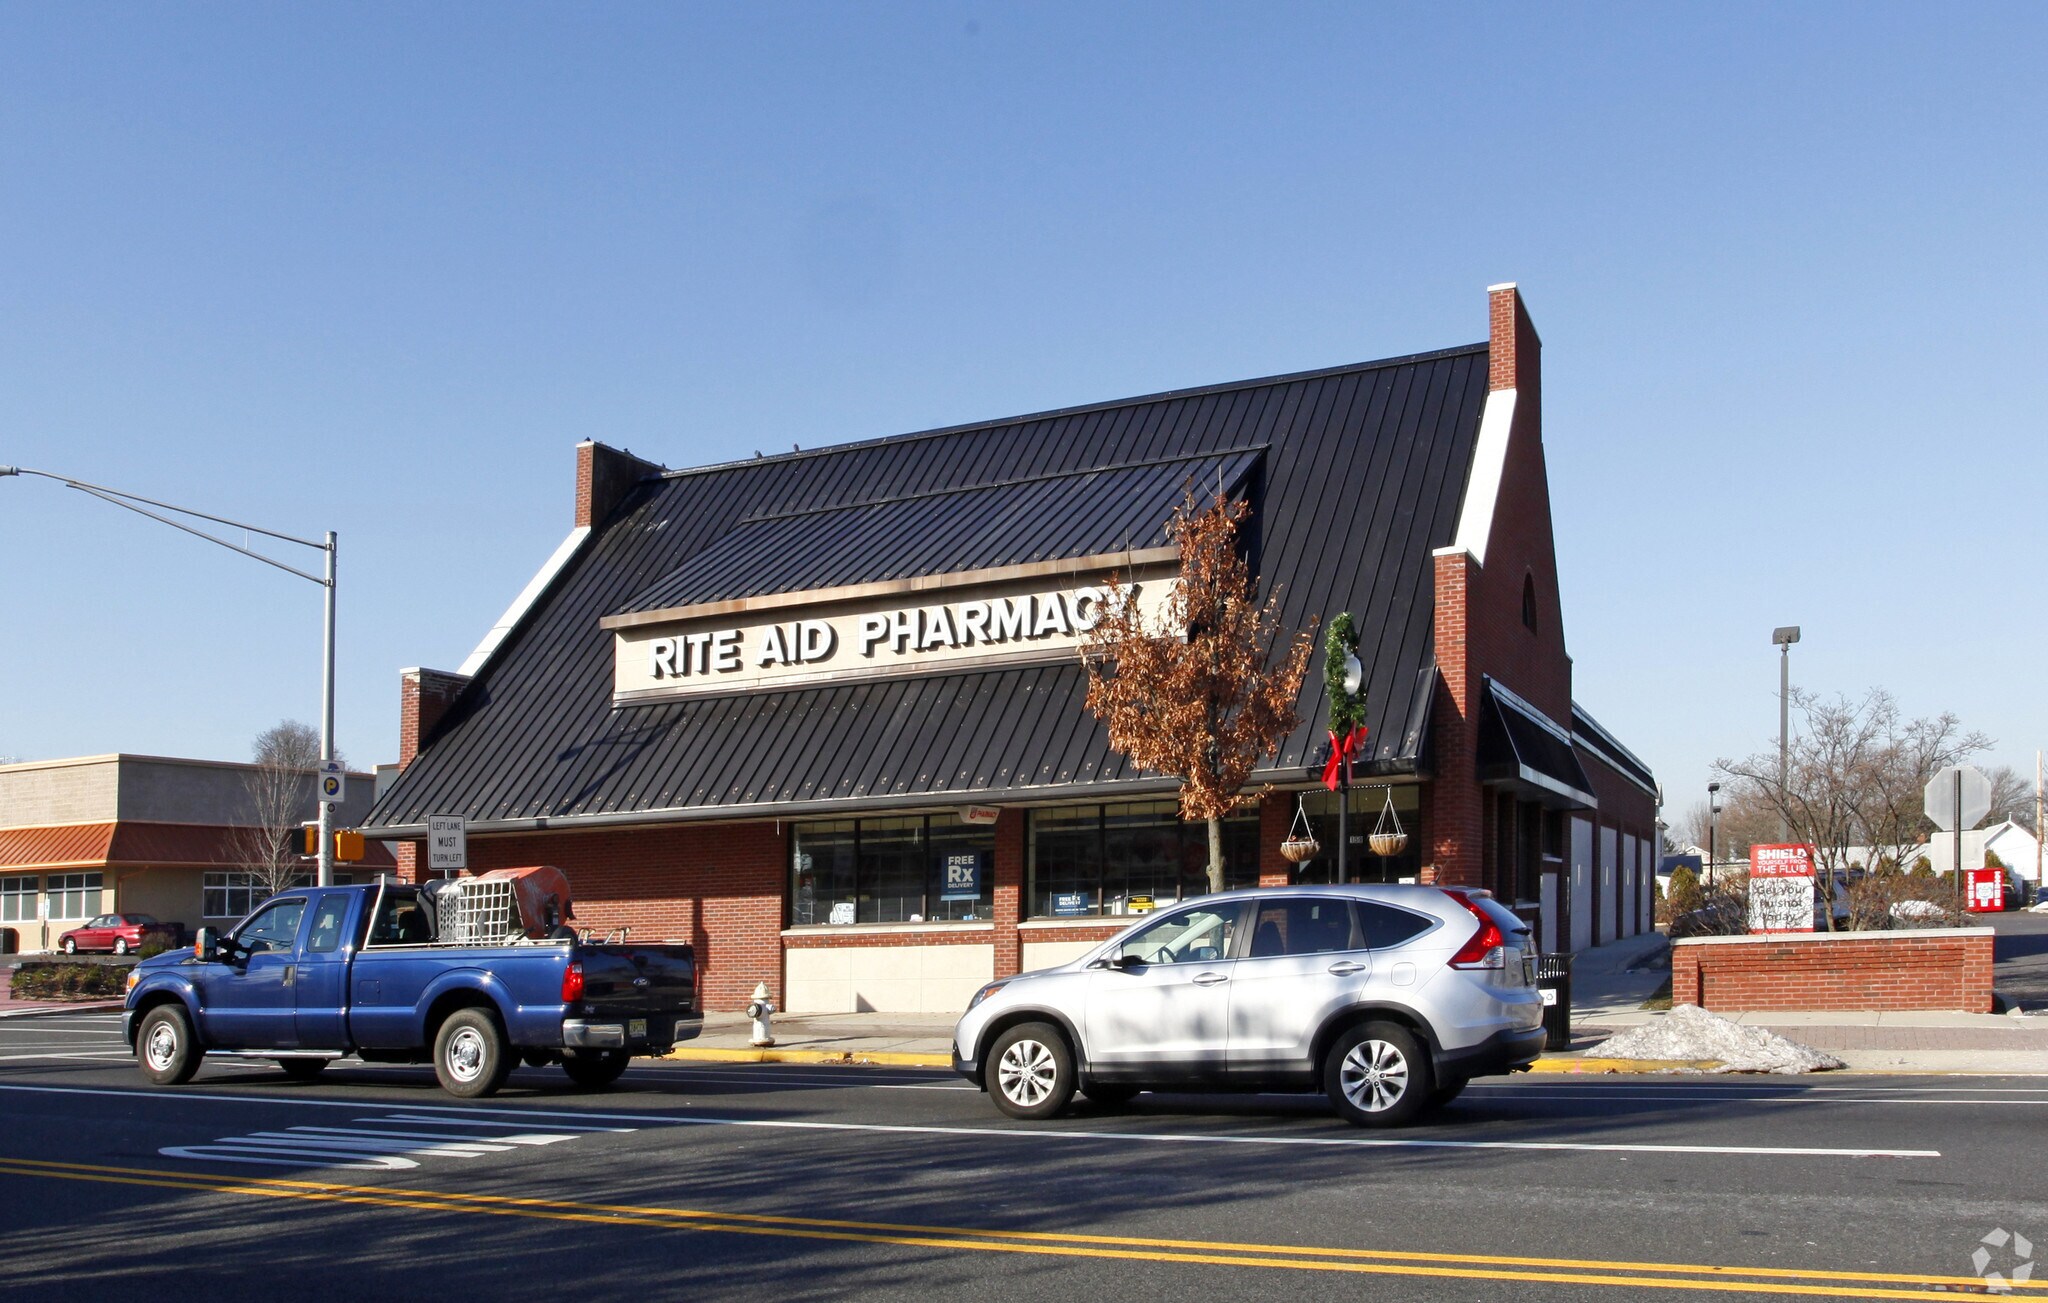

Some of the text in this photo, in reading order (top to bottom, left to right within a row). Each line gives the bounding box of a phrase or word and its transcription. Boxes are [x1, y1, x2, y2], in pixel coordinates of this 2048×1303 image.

[650, 630, 740, 677] RITE
[755, 620, 833, 666] AID
[326, 779, 337, 792] P
[432, 821, 461, 831] LEFT LANE
[438, 836, 457, 847] MUST
[433, 853, 462, 863] TURN LEFT
[1757, 848, 1807, 859] SHIELD
[948, 855, 975, 865] FREE
[947, 865, 974, 882] Rx
[1757, 864, 1799, 874] THE FLU
